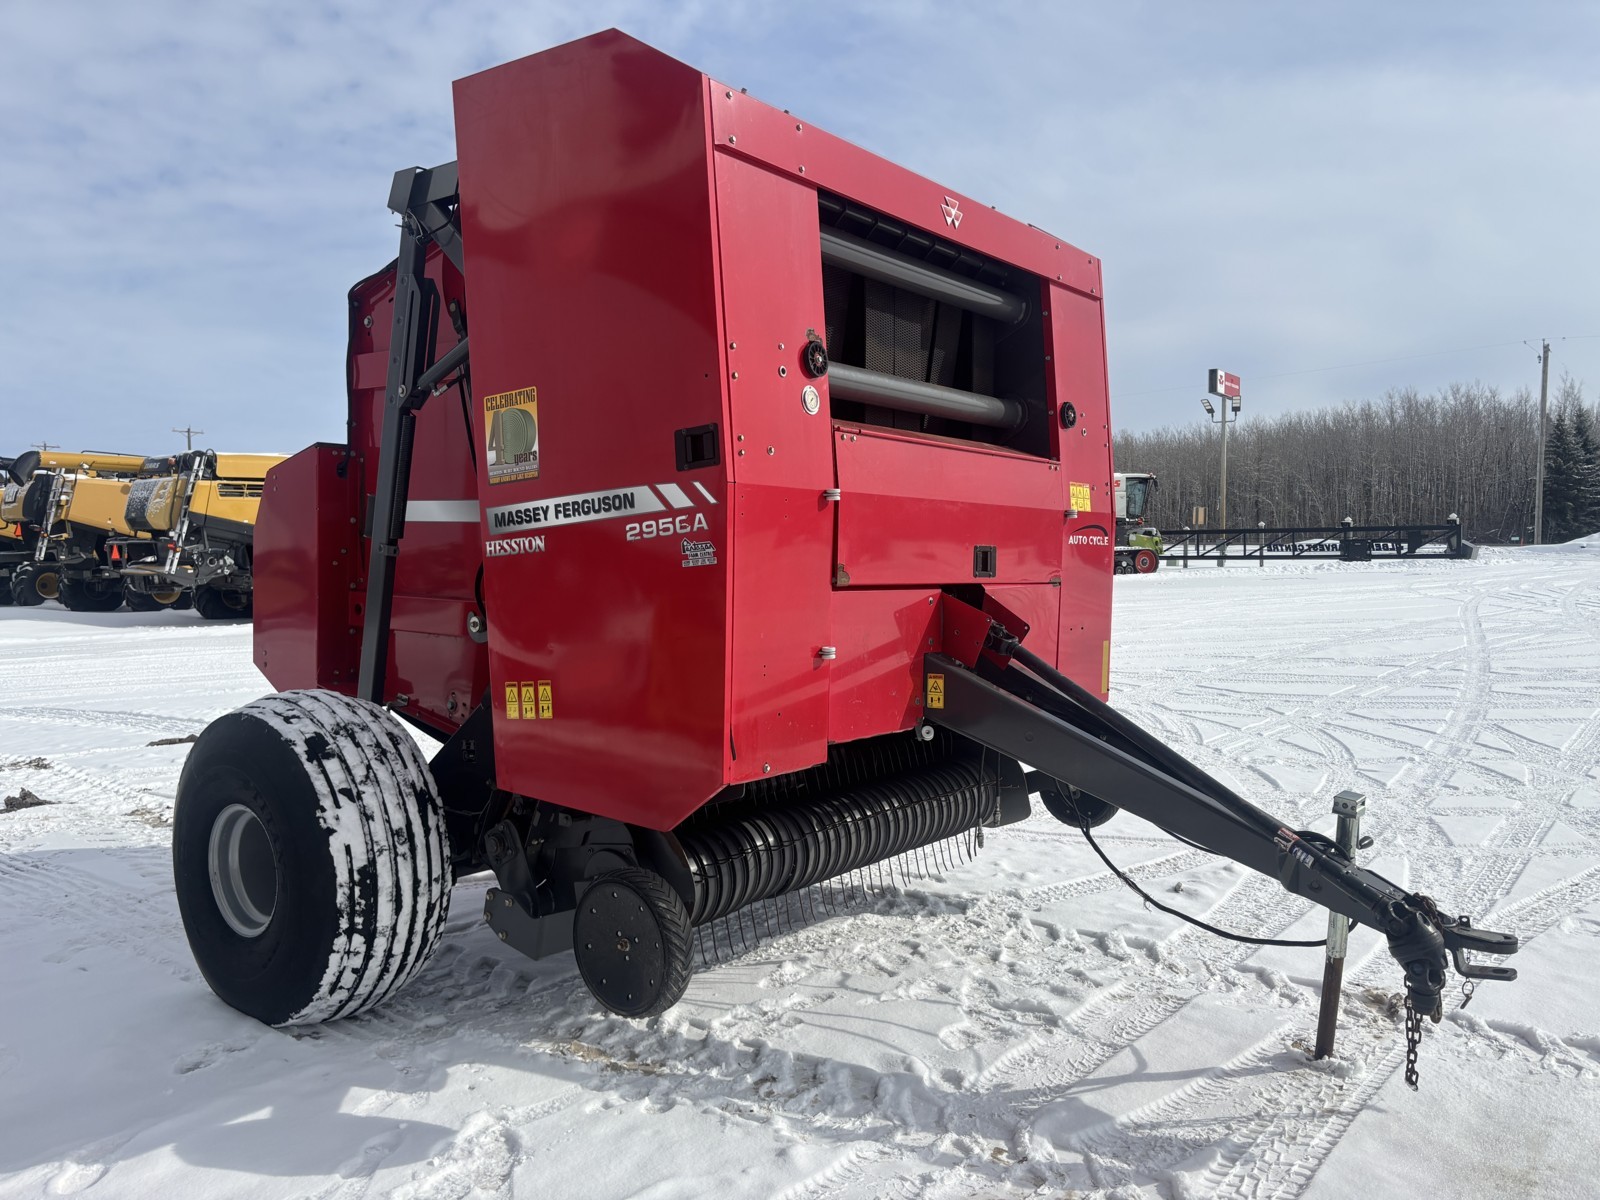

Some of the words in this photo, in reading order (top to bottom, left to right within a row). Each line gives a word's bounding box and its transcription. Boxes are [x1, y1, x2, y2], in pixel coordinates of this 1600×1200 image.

[485, 387, 536, 411] CELEBRATING
[513, 450, 538, 466] years
[494, 506, 550, 528] MASSEY
[554, 492, 635, 520] FERGUSON
[485, 535, 546, 557] HESSTON
[1068, 536, 1087, 545] AUTO
[1088, 536, 1109, 546] CYCLE
